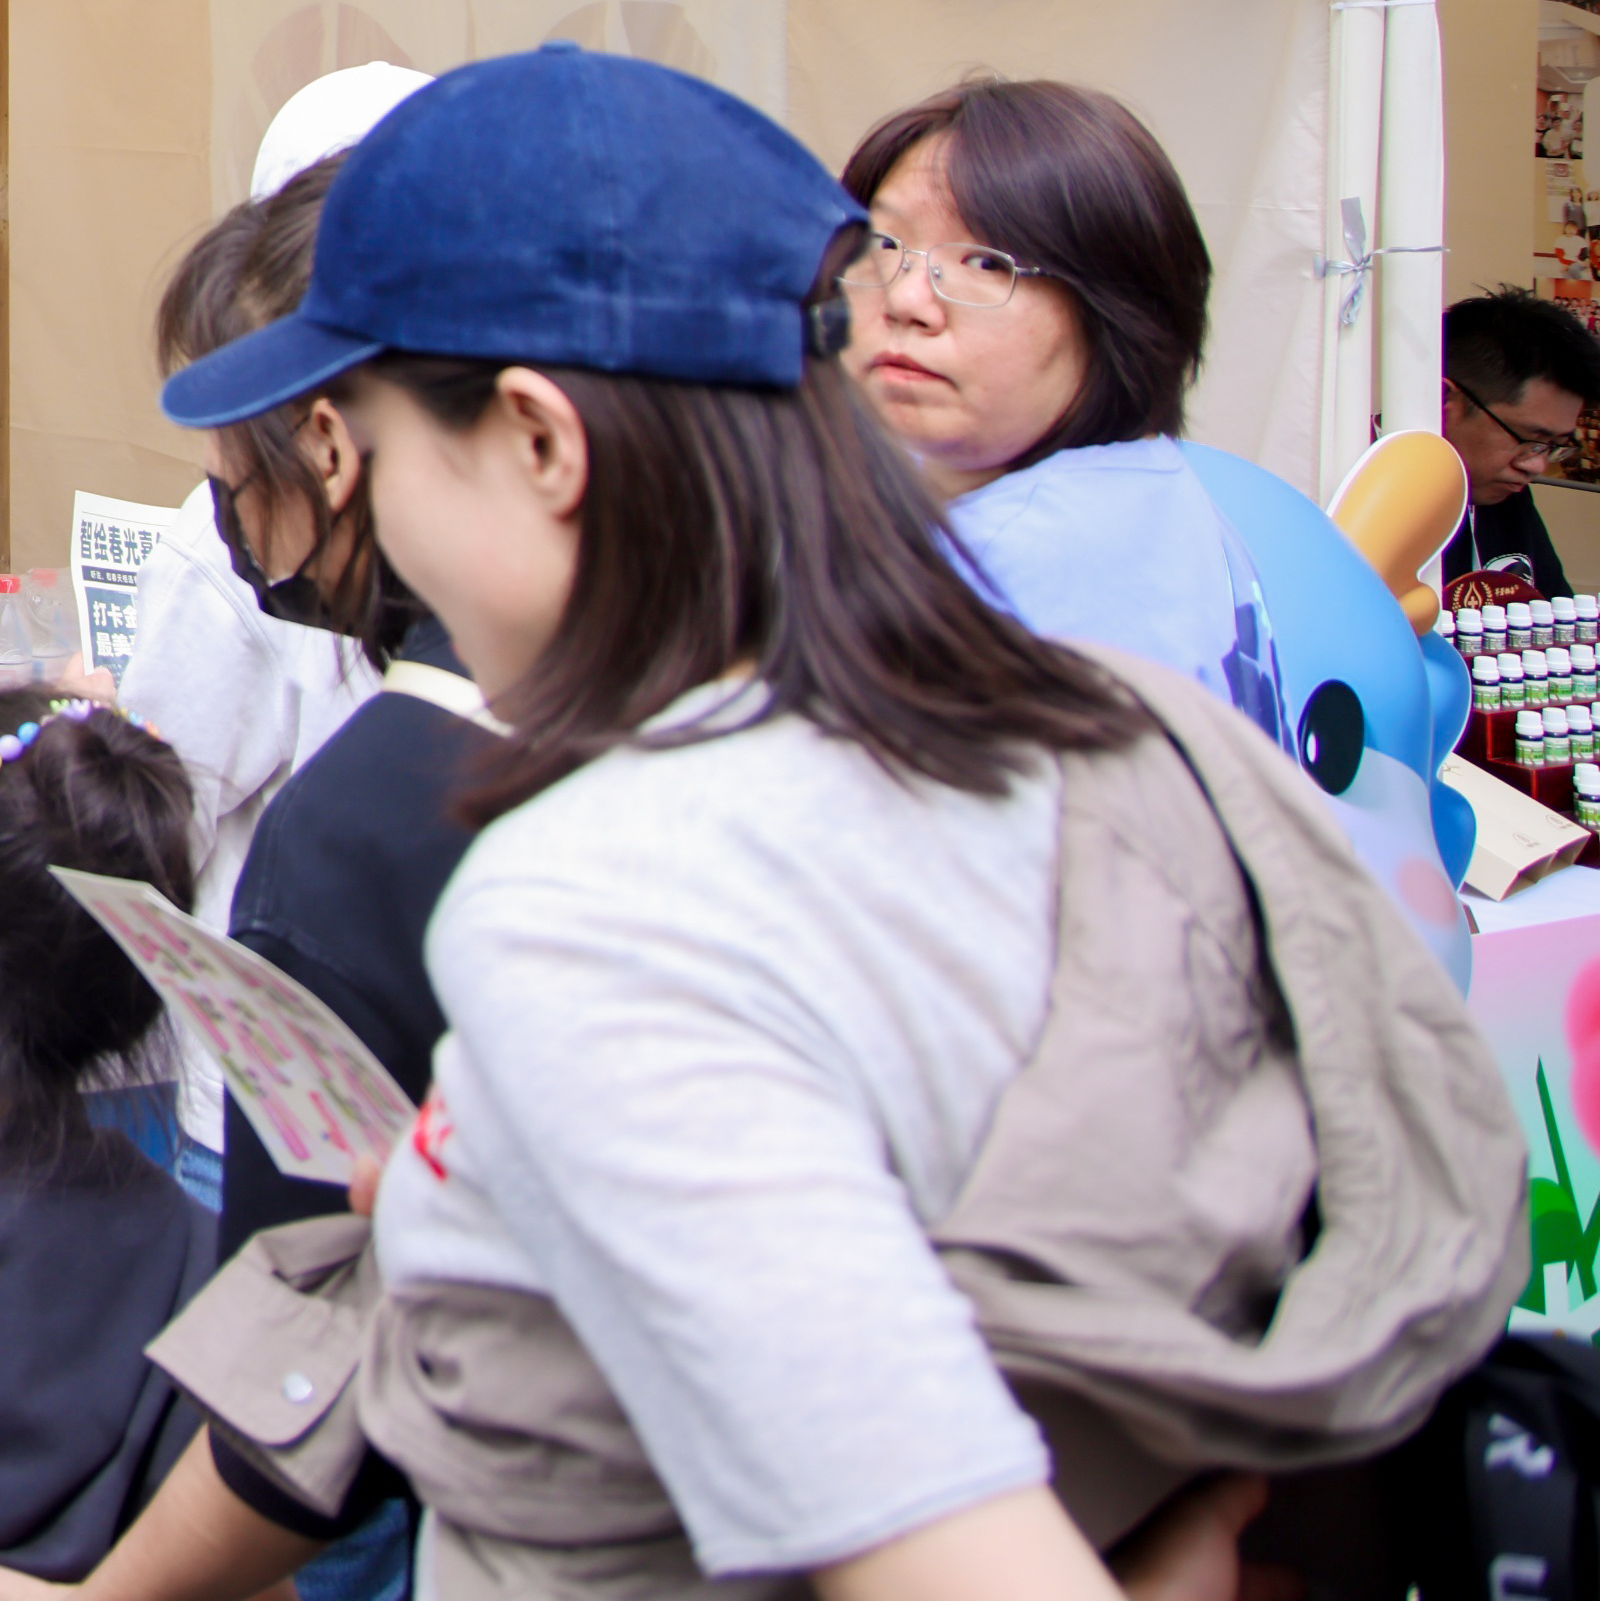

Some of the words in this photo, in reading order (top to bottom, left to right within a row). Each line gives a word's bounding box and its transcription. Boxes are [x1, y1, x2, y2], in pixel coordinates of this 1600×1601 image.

[80, 518, 161, 566] 智绘春光嘉
[96, 631, 136, 658] 最美
